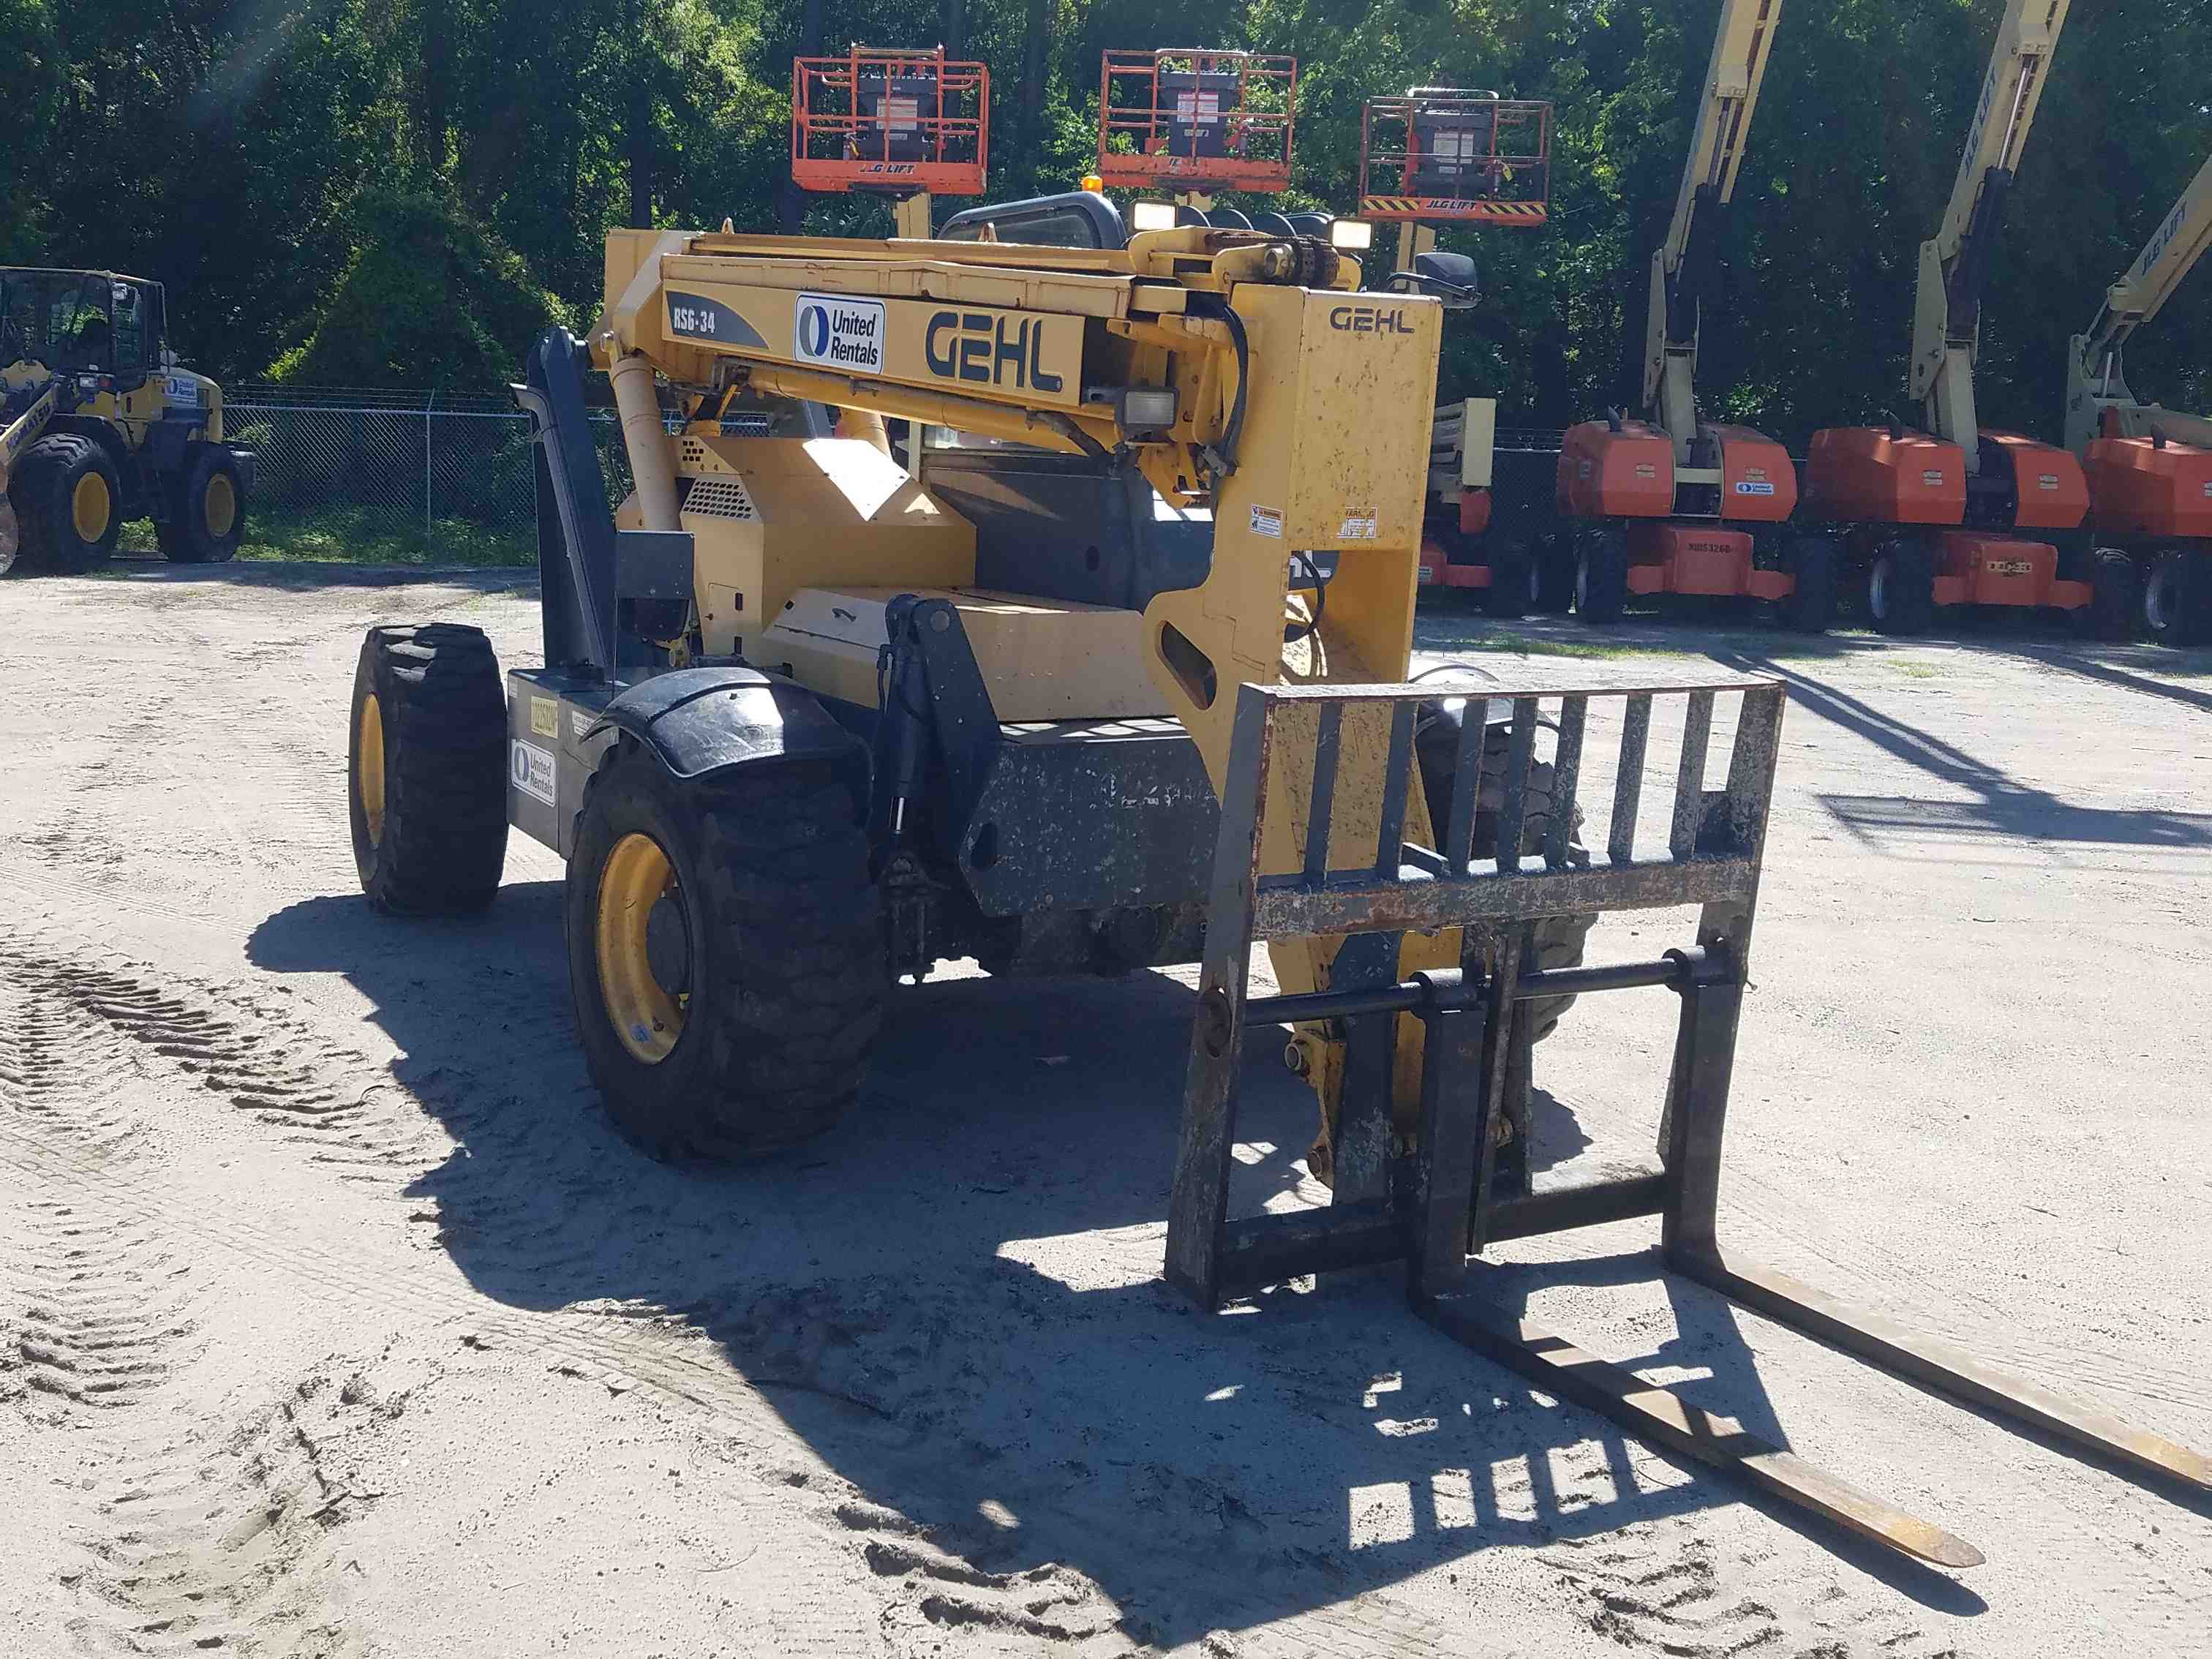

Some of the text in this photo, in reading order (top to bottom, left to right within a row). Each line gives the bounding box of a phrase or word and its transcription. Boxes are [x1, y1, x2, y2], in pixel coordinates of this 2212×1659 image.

[886, 164, 915, 174] LIFT
[1426, 199, 1478, 211] JLG LIFT
[831, 309, 877, 338] United
[1330, 306, 1416, 334] GEHL
[830, 336, 879, 366] Rentals
[925, 311, 1064, 394] GEHL
[530, 752, 552, 777] United
[530, 770, 554, 797] Rentals
